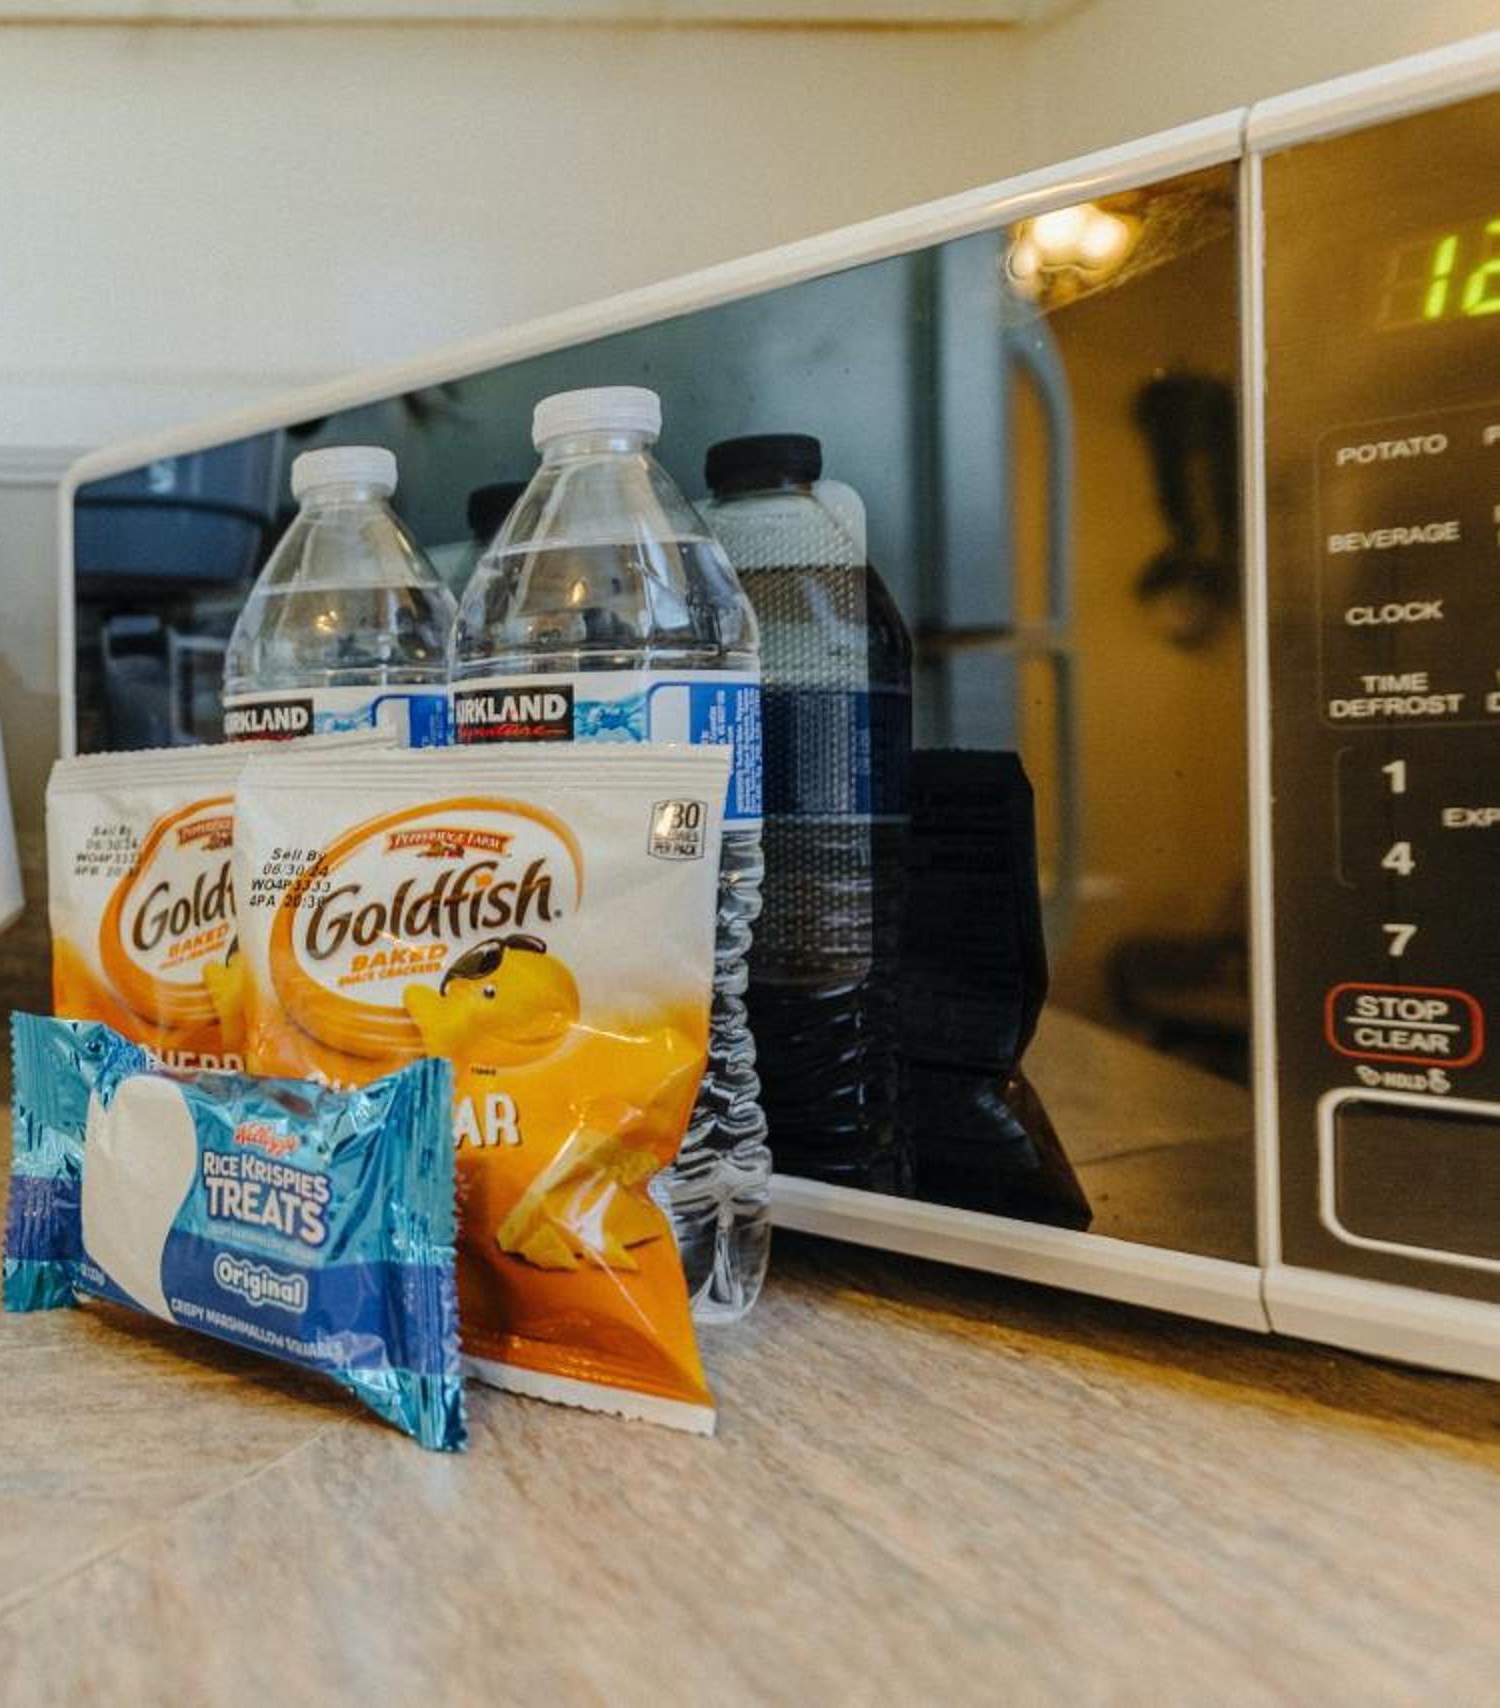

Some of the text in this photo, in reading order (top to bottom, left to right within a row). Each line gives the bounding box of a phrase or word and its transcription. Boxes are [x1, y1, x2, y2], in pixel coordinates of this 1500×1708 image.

[1336, 433, 1448, 467] POTATO
[1327, 521, 1461, 554] BEVERAGE
[1345, 600, 1444, 625] CLOCK
[1360, 672, 1429, 692] TIME
[1329, 693, 1465, 719] DEFROST
[1382, 759, 1406, 794] 1
[271, 847, 303, 861] Sell
[1381, 841, 1416, 876] 4
[1382, 923, 1417, 957] 7
[352, 943, 449, 973] BAKED
[1355, 995, 1449, 1021] STOP
[1353, 1027, 1450, 1053] CLEAR
[203, 1151, 331, 1204] RICE KRISPIES
[205, 1177, 326, 1245] TREATS
[218, 1259, 302, 1307] Original
